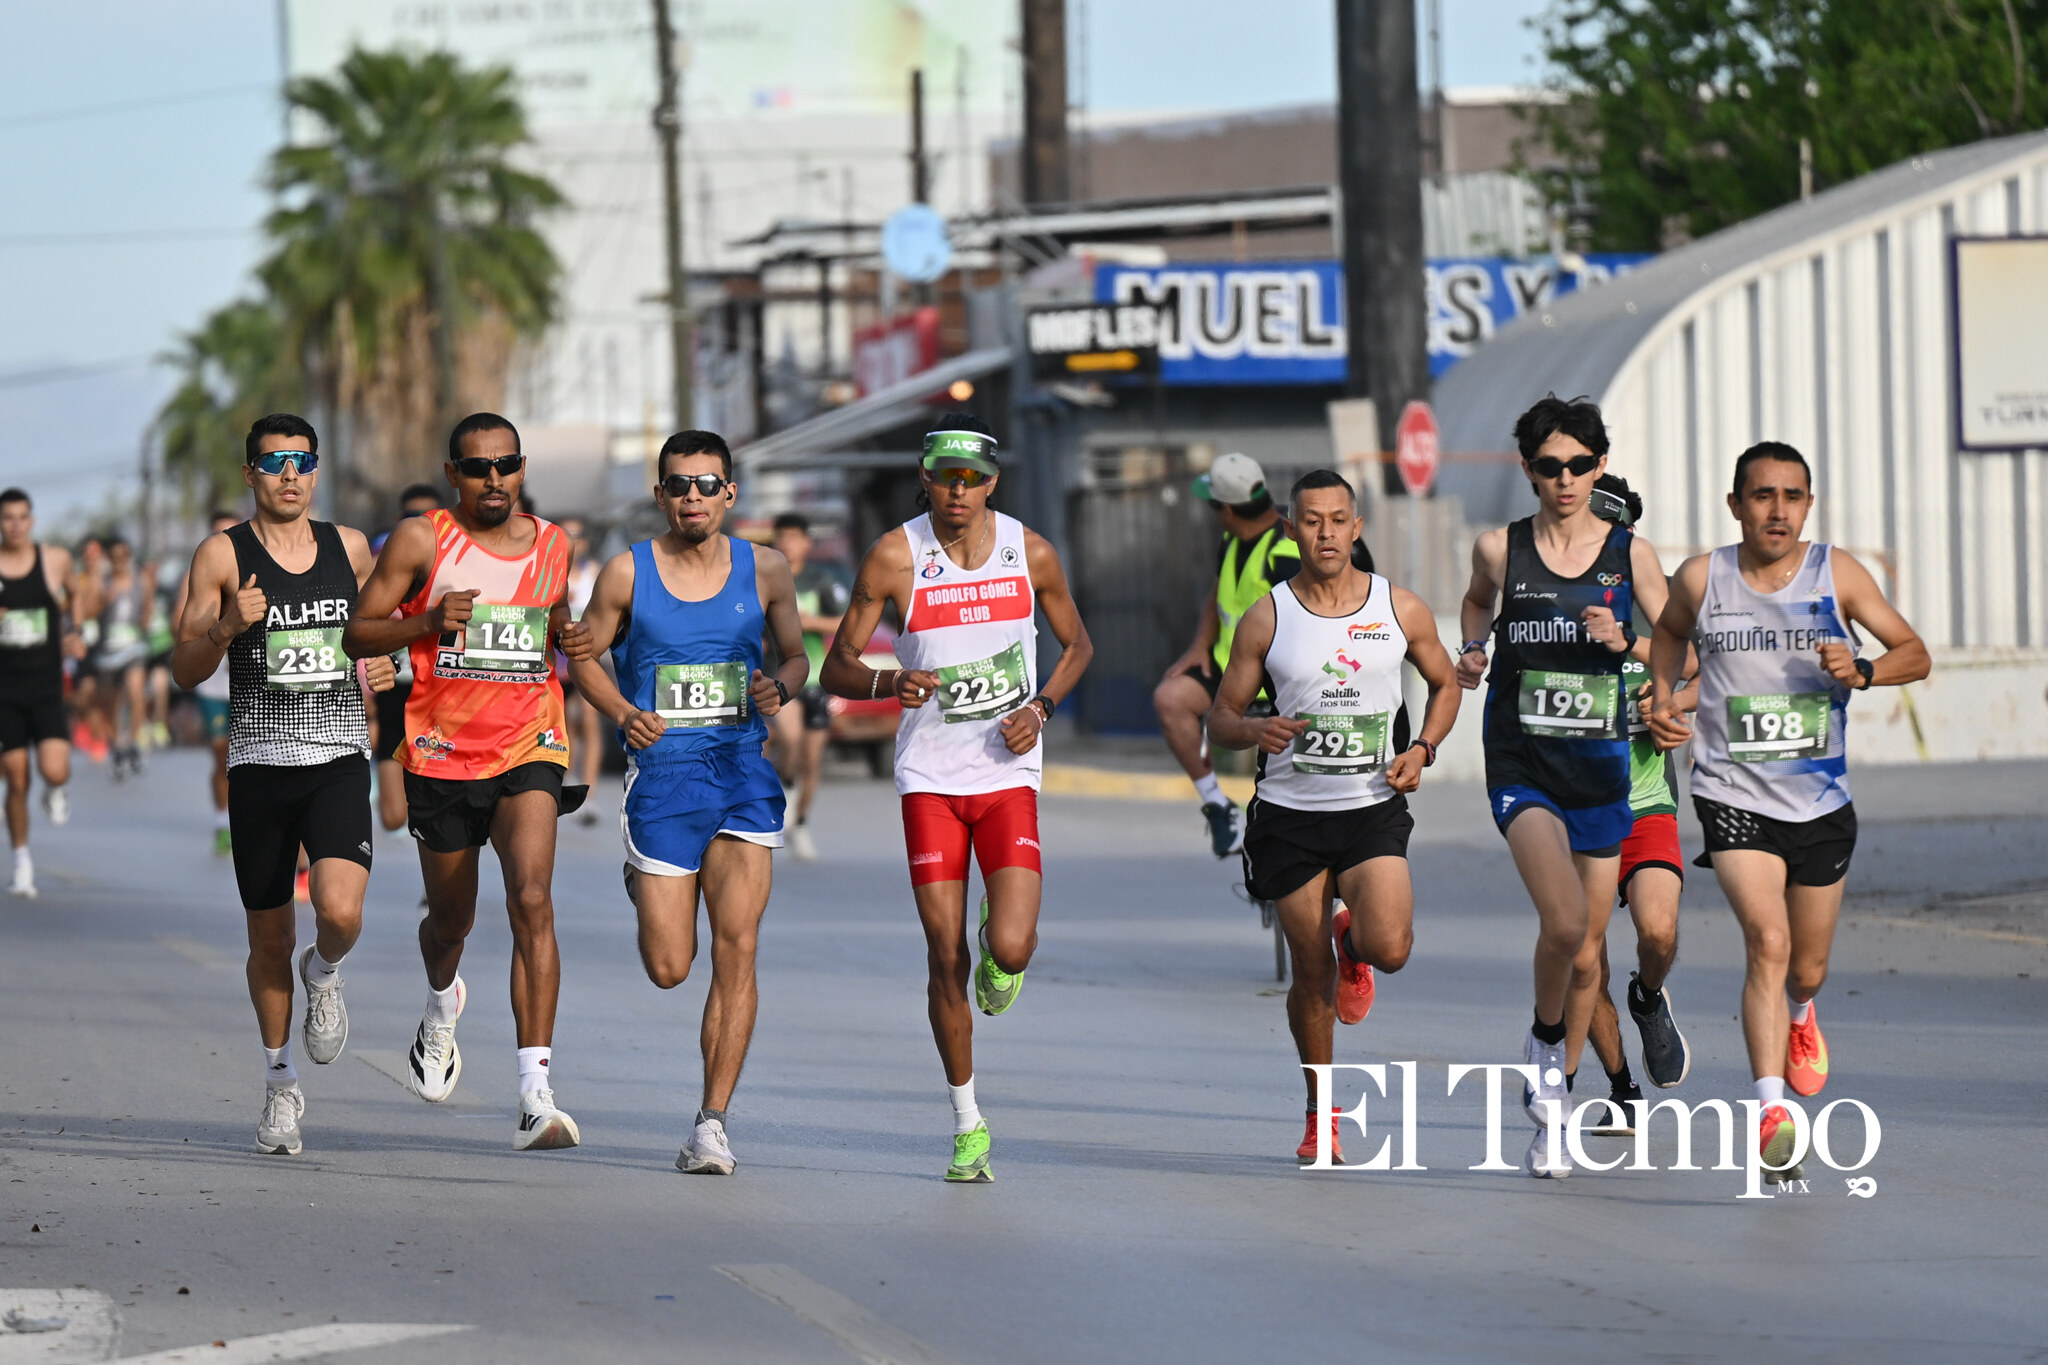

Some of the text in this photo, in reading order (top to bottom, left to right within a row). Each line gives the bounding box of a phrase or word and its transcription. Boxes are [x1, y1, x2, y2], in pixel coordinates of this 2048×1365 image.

[1113, 271, 1495, 359] MUELS
[926, 581, 1019, 607] RODOLFO GÓMEZ
[266, 598, 349, 628] ALHER
[960, 605, 991, 624] CLUB
[480, 622, 535, 651] 146
[1353, 632, 1391, 641] CROC
[1508, 616, 1578, 644] ORDUÑA
[1705, 625, 1832, 655] ORDUÑA TEAM
[278, 645, 337, 674] 238
[1016, 653, 1029, 695] MEDALLA
[433, 668, 459, 679] CLUB
[460, 671, 492, 682] NORA
[492, 673, 528, 684] LETICIA
[949, 668, 1010, 708] 225
[669, 681, 726, 709] 185
[739, 675, 748, 718] MEDALLA
[1320, 699, 1361, 708] nos une.
[1321, 688, 1361, 699] Saltillo
[1533, 688, 1594, 719] 199
[1605, 688, 1616, 732] MEDALLA
[1740, 711, 1804, 741] 198
[1816, 705, 1828, 749] MEDALLA
[1304, 730, 1364, 757] 295
[1375, 724, 1386, 765] MEDALLA
